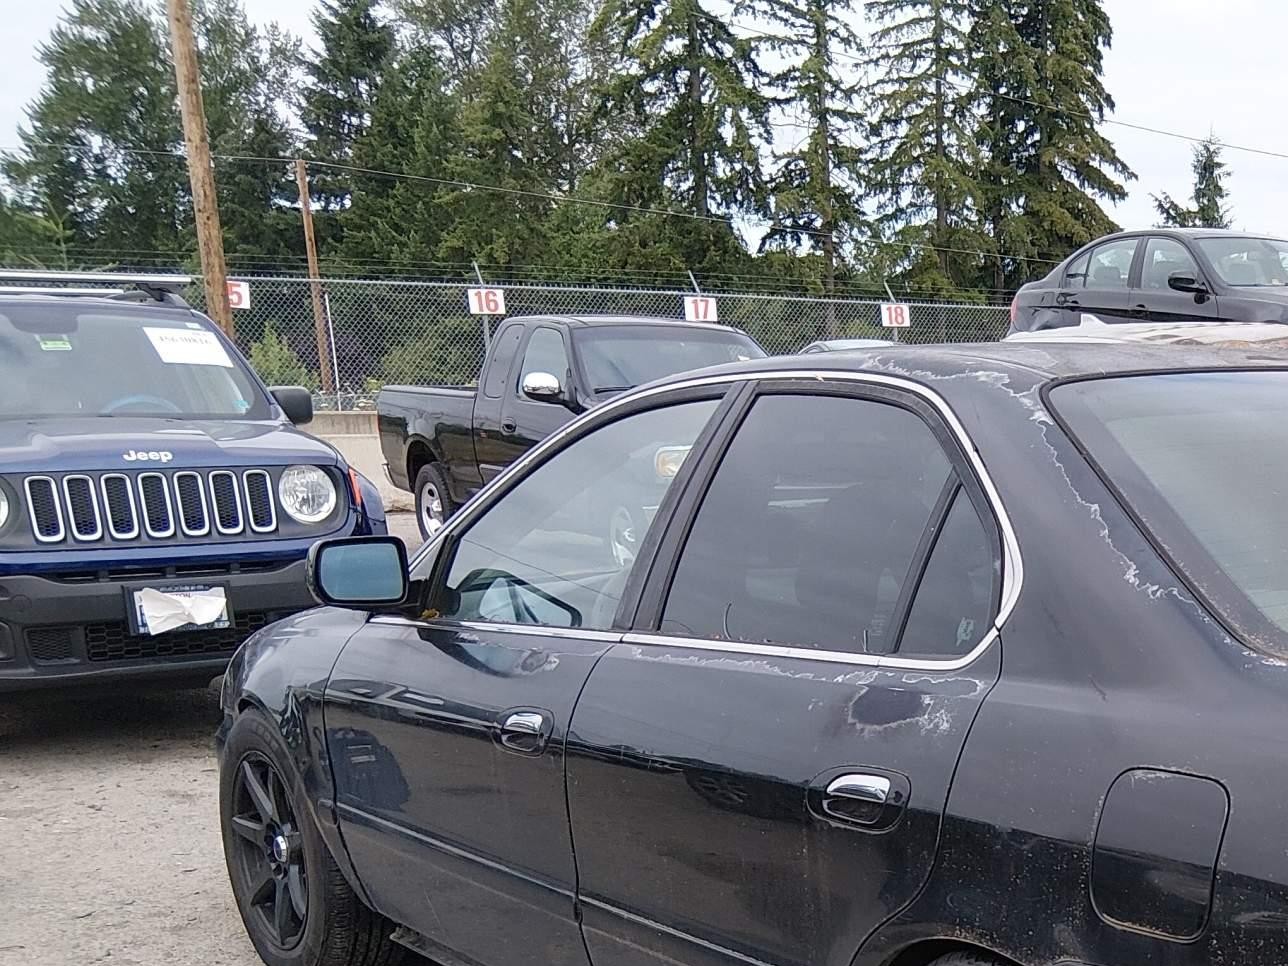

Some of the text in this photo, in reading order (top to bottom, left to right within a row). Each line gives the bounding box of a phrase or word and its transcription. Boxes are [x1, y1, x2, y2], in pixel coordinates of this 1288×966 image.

[474, 290, 499, 313] 16
[691, 298, 709, 320] 17
[886, 306, 905, 326] 18
[122, 449, 173, 463] Jeep
